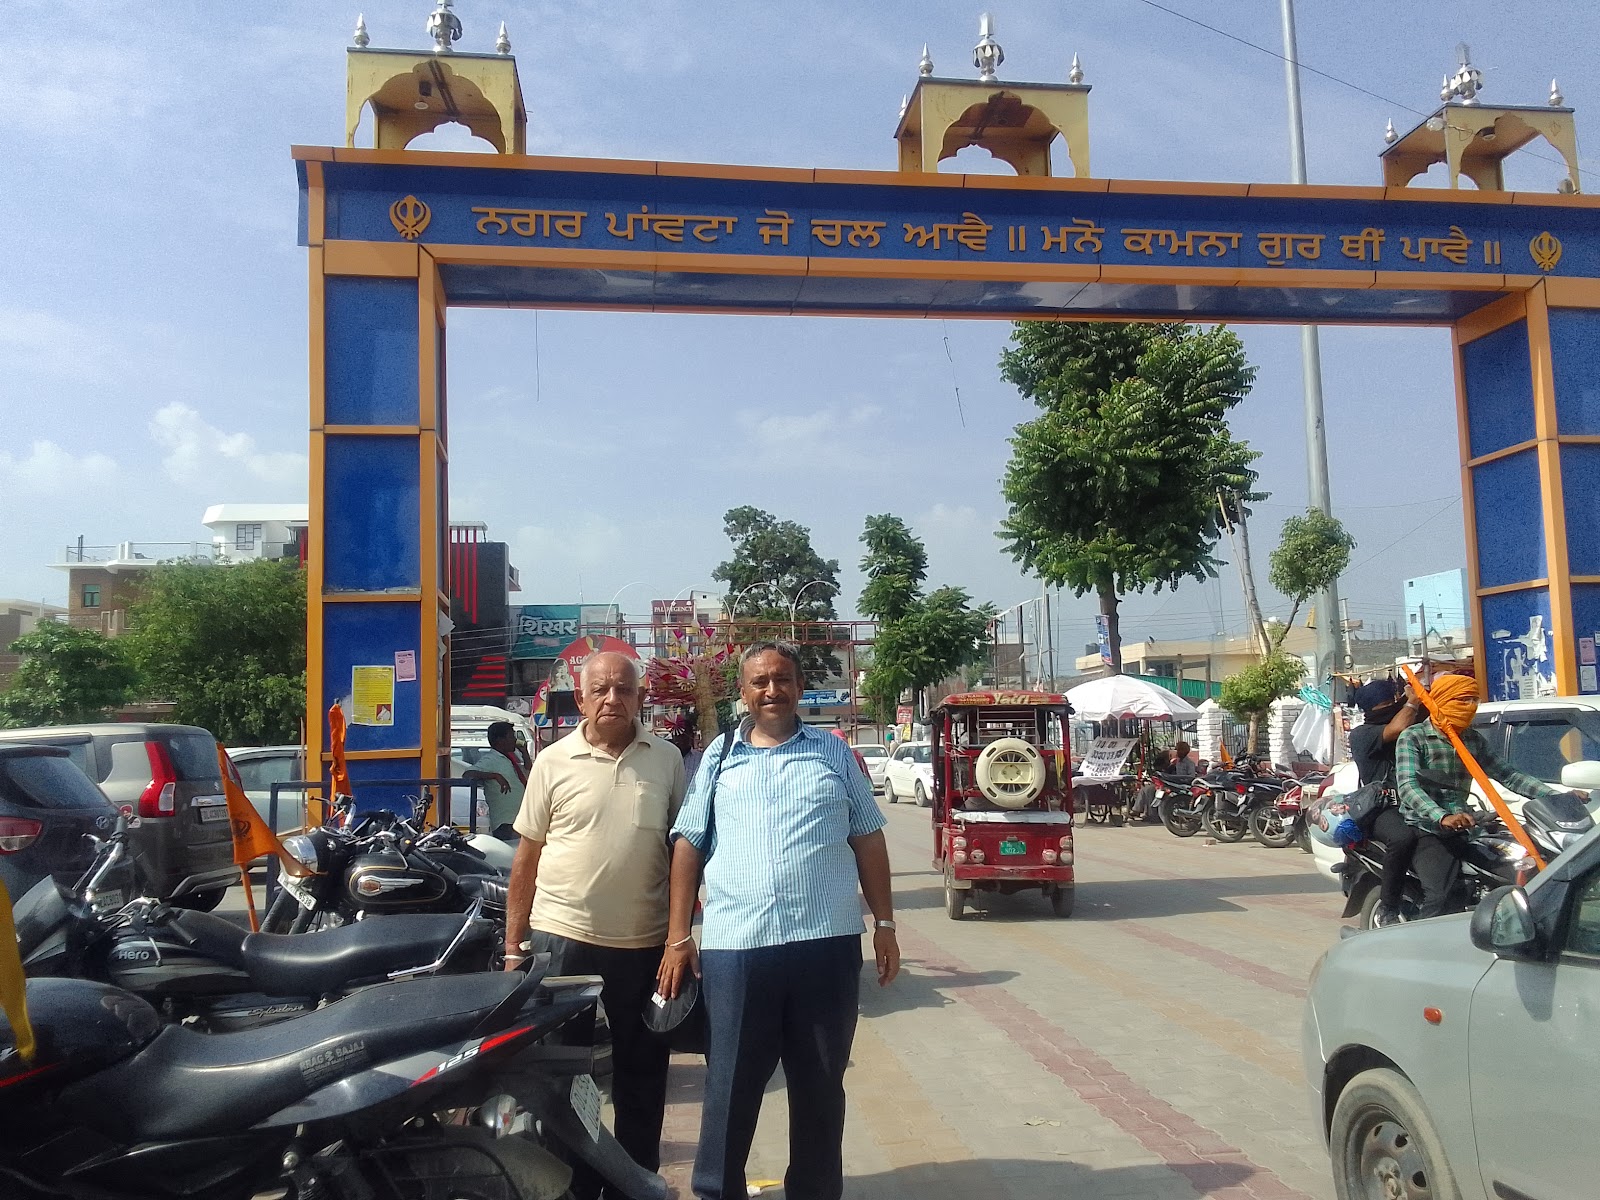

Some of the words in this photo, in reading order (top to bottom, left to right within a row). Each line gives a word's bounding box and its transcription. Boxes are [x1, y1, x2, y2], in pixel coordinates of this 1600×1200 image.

[471, 206, 588, 238] ਨਗਰ
[604, 204, 739, 242] ਪਾਂਵਟਾ
[755, 207, 795, 246] ਜੋ
[810, 218, 887, 248] ਚਲ
[902, 211, 993, 250] ਆਵੈ
[1040, 216, 1105, 253] ਮਨੋ
[1120, 228, 1243, 257] ਕਾਮਨਾ
[1256, 232, 1327, 266] ਗੁਰ
[1399, 225, 1473, 265] ਪਾਵੈ
[519, 615, 578, 636] शिखर
[118, 950, 150, 960] Hero
[336, 1041, 365, 1057] BAJAJ
[438, 1045, 480, 1073] 125
